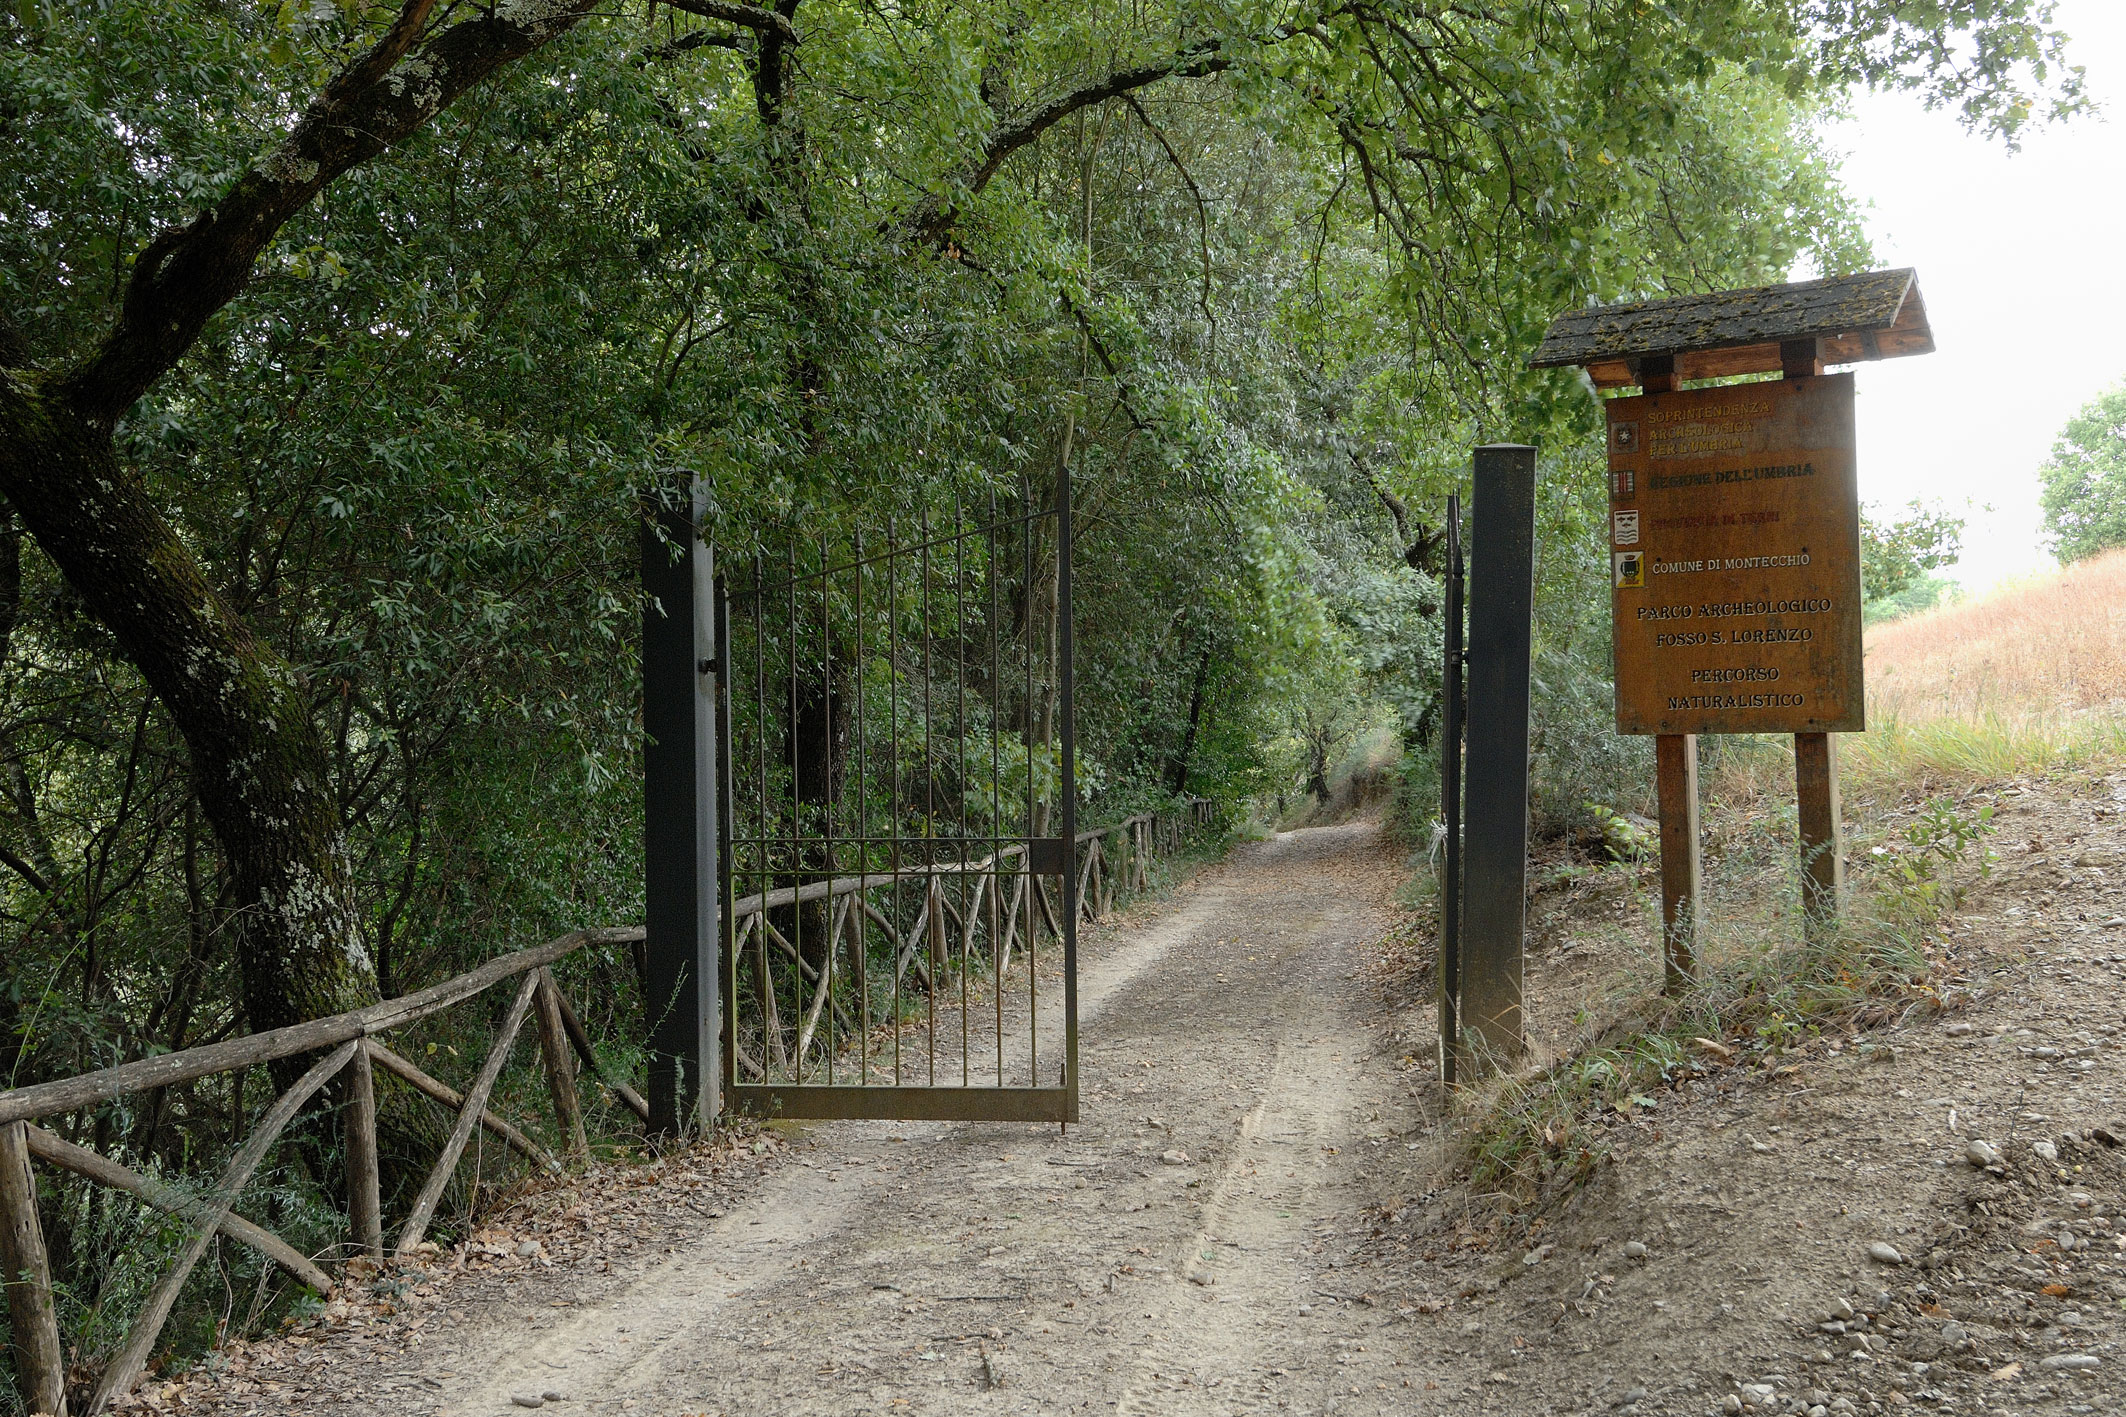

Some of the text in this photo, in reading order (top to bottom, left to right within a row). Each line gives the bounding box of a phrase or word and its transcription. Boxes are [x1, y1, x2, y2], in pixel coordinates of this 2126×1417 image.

[1648, 401, 1771, 424] SOPRINTENDENZA
[1648, 422, 1754, 441] ARCHEOLOGICA
[1649, 443, 1677, 456] PER
[1650, 472, 1713, 490] REGIONE
[1652, 554, 1811, 575] COMUNE DI MONTECCHIO
[1637, 598, 1832, 620] PARCO ARCHEOLOGICO
[1655, 628, 1814, 647] FOSSO S. LORENZO
[1691, 667, 1780, 683] PERCORSO
[1668, 693, 1805, 711] NATURALISTICO
